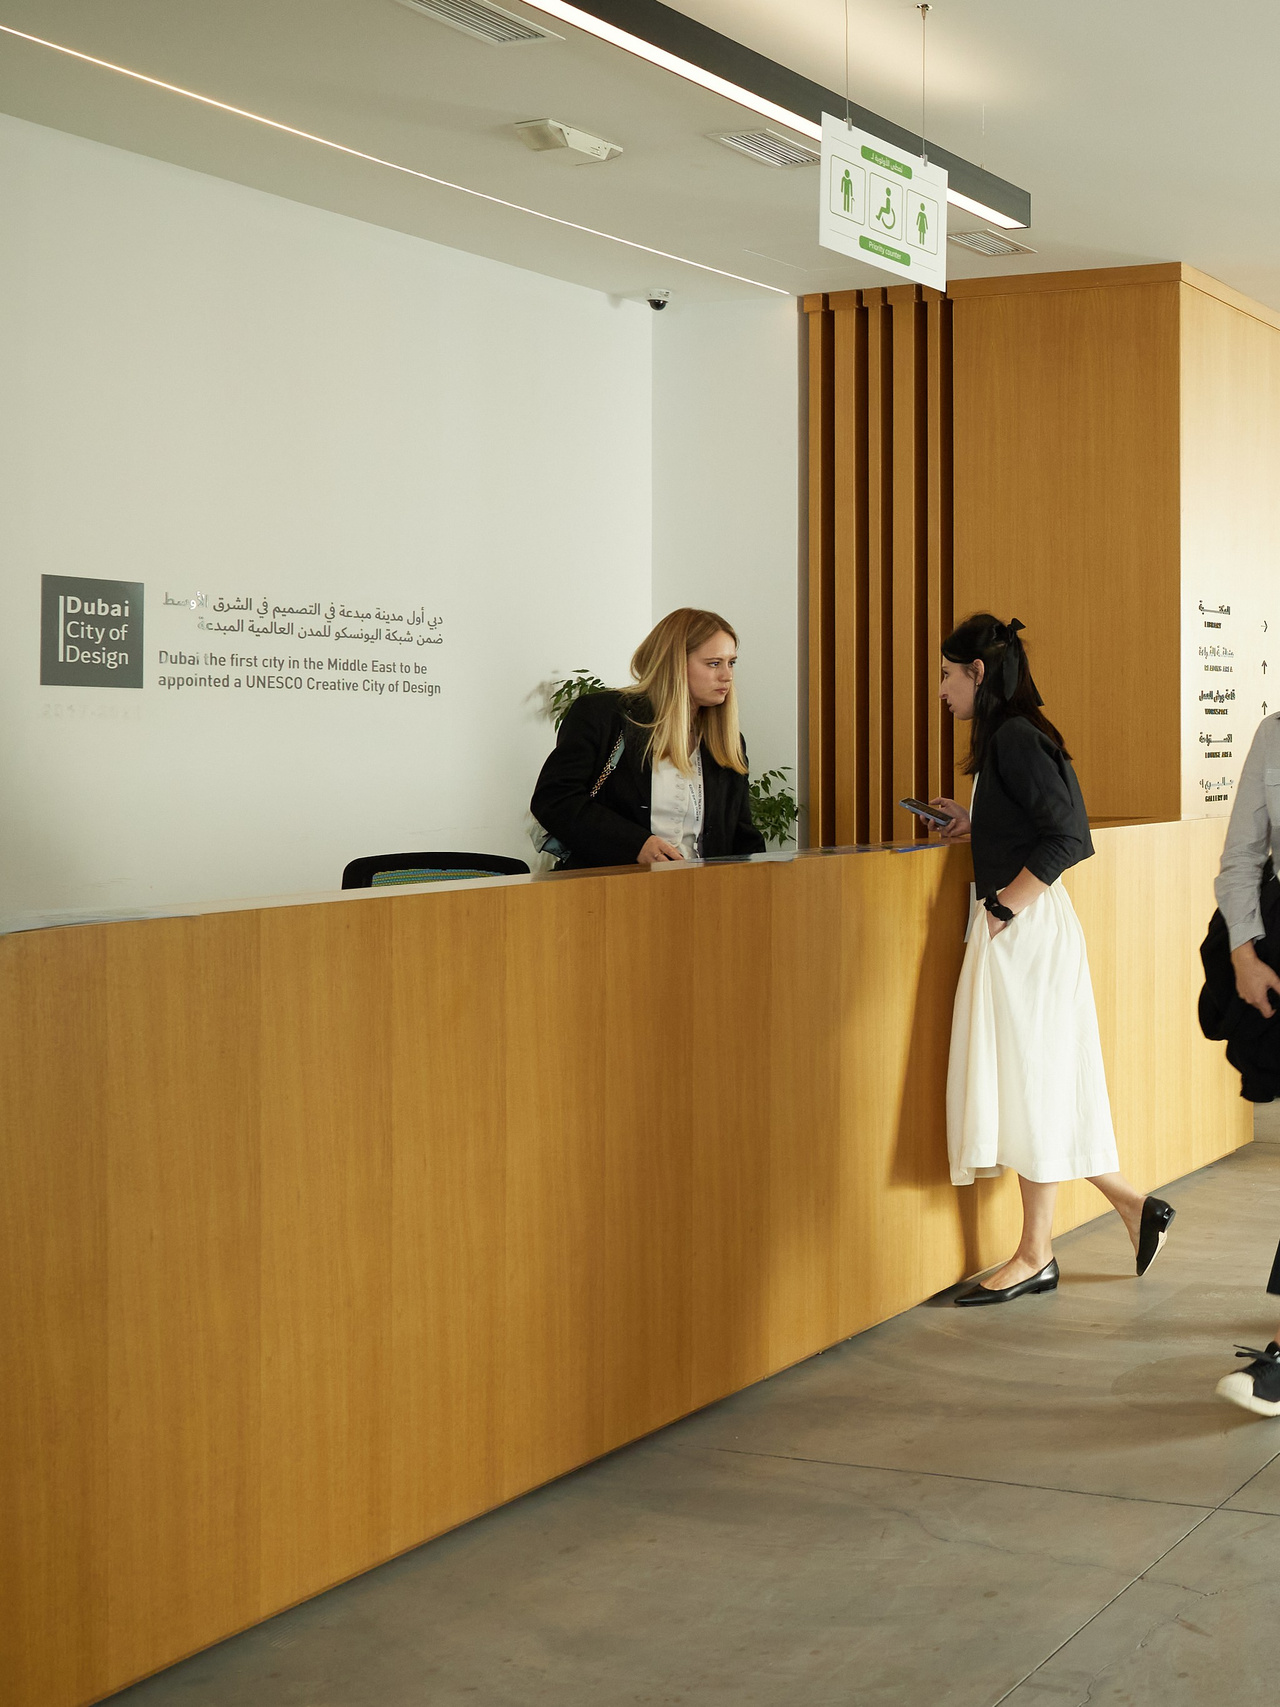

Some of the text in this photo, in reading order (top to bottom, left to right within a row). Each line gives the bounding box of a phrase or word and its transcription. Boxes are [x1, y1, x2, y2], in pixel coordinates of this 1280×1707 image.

[869, 240, 901, 259] Priority counter
[66, 595, 129, 617] Dubai
[213, 597, 252, 612] الشرق
[256, 597, 268, 619] في
[272, 603, 320, 619] التصميم
[324, 602, 336, 623] في
[339, 604, 371, 622] مبدعة
[375, 608, 403, 624] مدينة
[407, 607, 424, 625] أول
[427, 616, 443, 630] دبي
[66, 620, 128, 644] City of
[197, 616, 443, 646] ضمن شبكة اليونسكو للمدن العالمية المبدعة
[66, 645, 128, 669] Design
[159, 650, 427, 674] Dubai the first city in the Middle East to be
[158, 674, 440, 696] appointed a UNESCO Creative City of Design
